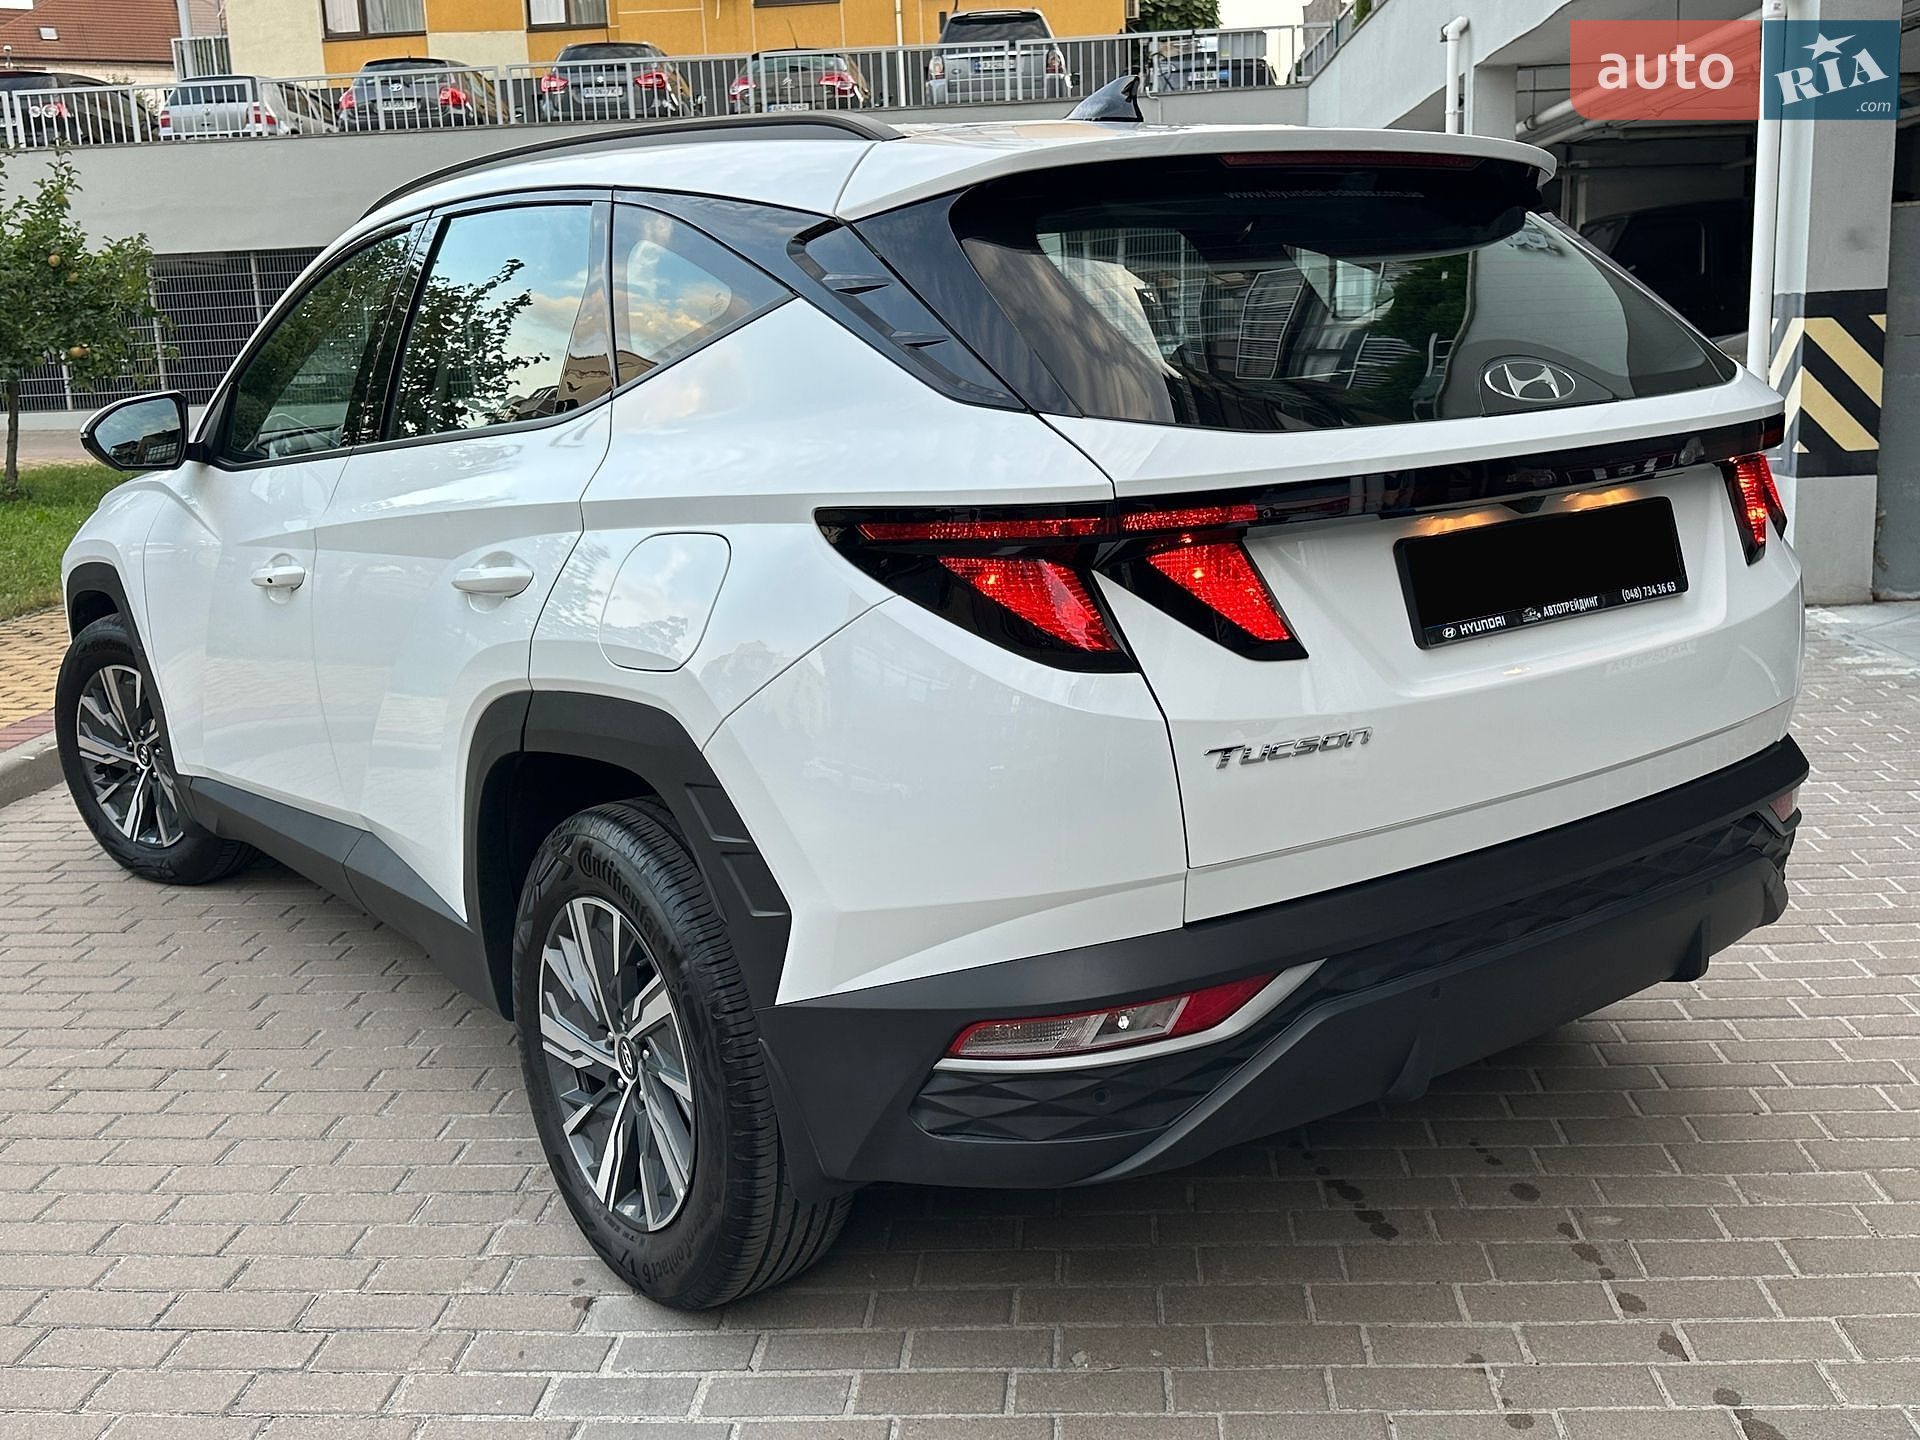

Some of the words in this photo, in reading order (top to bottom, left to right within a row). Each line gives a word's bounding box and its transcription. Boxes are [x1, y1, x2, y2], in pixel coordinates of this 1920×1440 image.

[1621, 585, 1642, 602] (048)
[1642, 584, 1657, 597] 734
[1656, 583, 1667, 594] 36
[1666, 581, 1677, 593] 63
[1542, 595, 1600, 618] АВТОТРЕЙДИНГ
[1459, 615, 1507, 636] HYUNDAI
